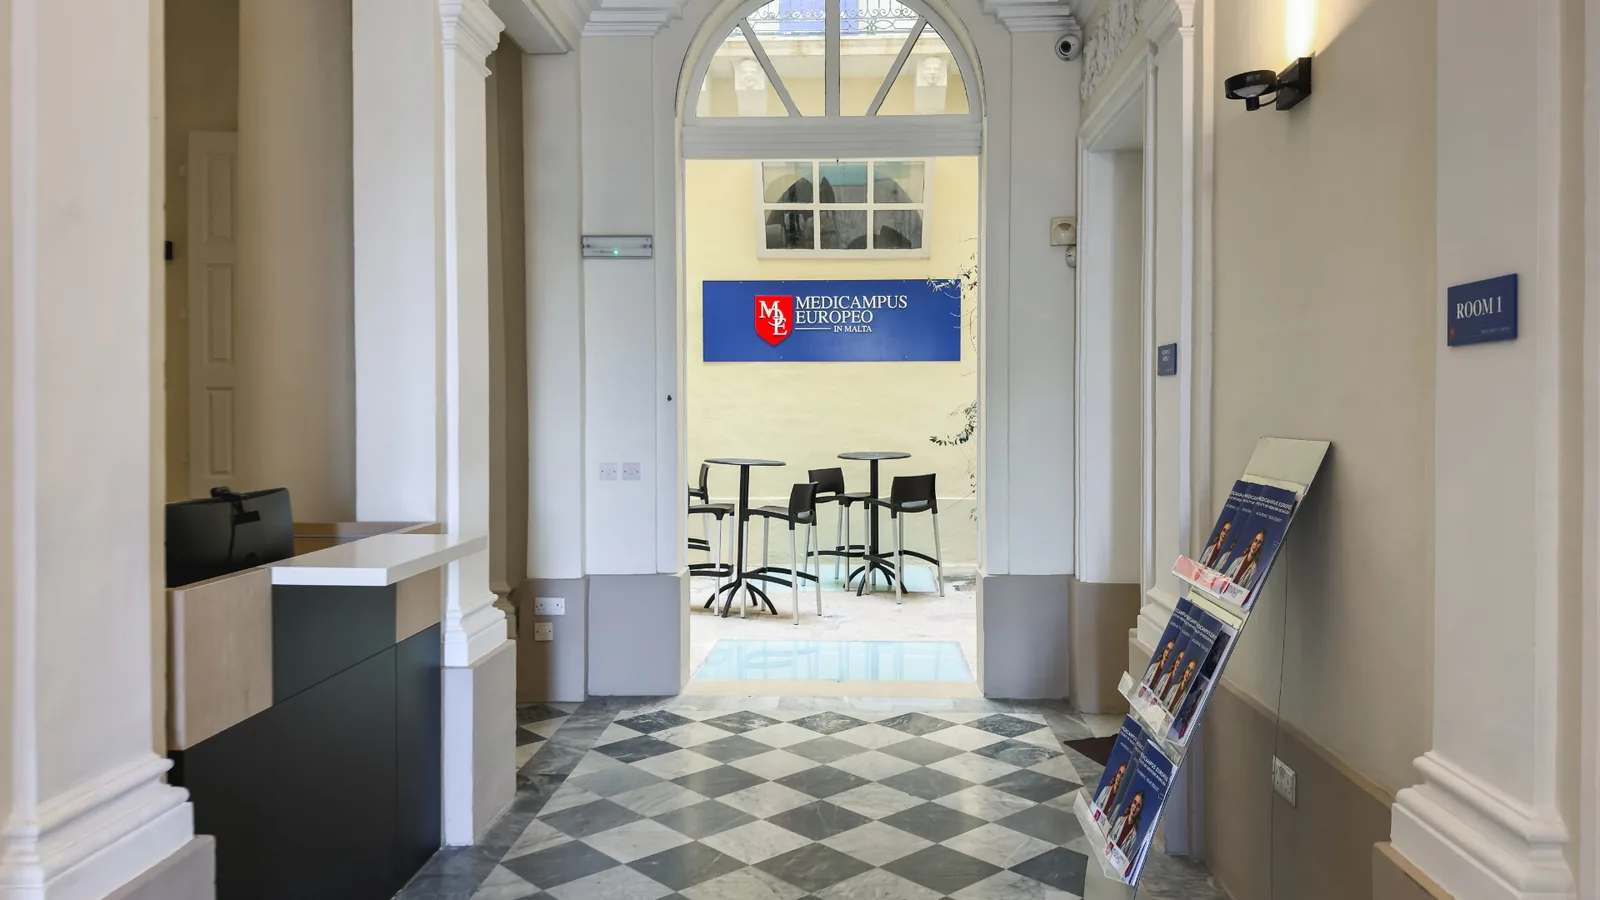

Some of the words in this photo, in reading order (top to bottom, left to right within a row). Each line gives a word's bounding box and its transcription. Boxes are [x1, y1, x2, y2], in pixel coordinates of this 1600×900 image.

[795, 294, 908, 310] MEDICAMPUS
[1456, 297, 1493, 319] ROOM
[1496, 296, 1502, 313] 1
[795, 310, 874, 325] EUROPEO
[833, 325, 843, 333] IN
[844, 325, 873, 333] MALTA
